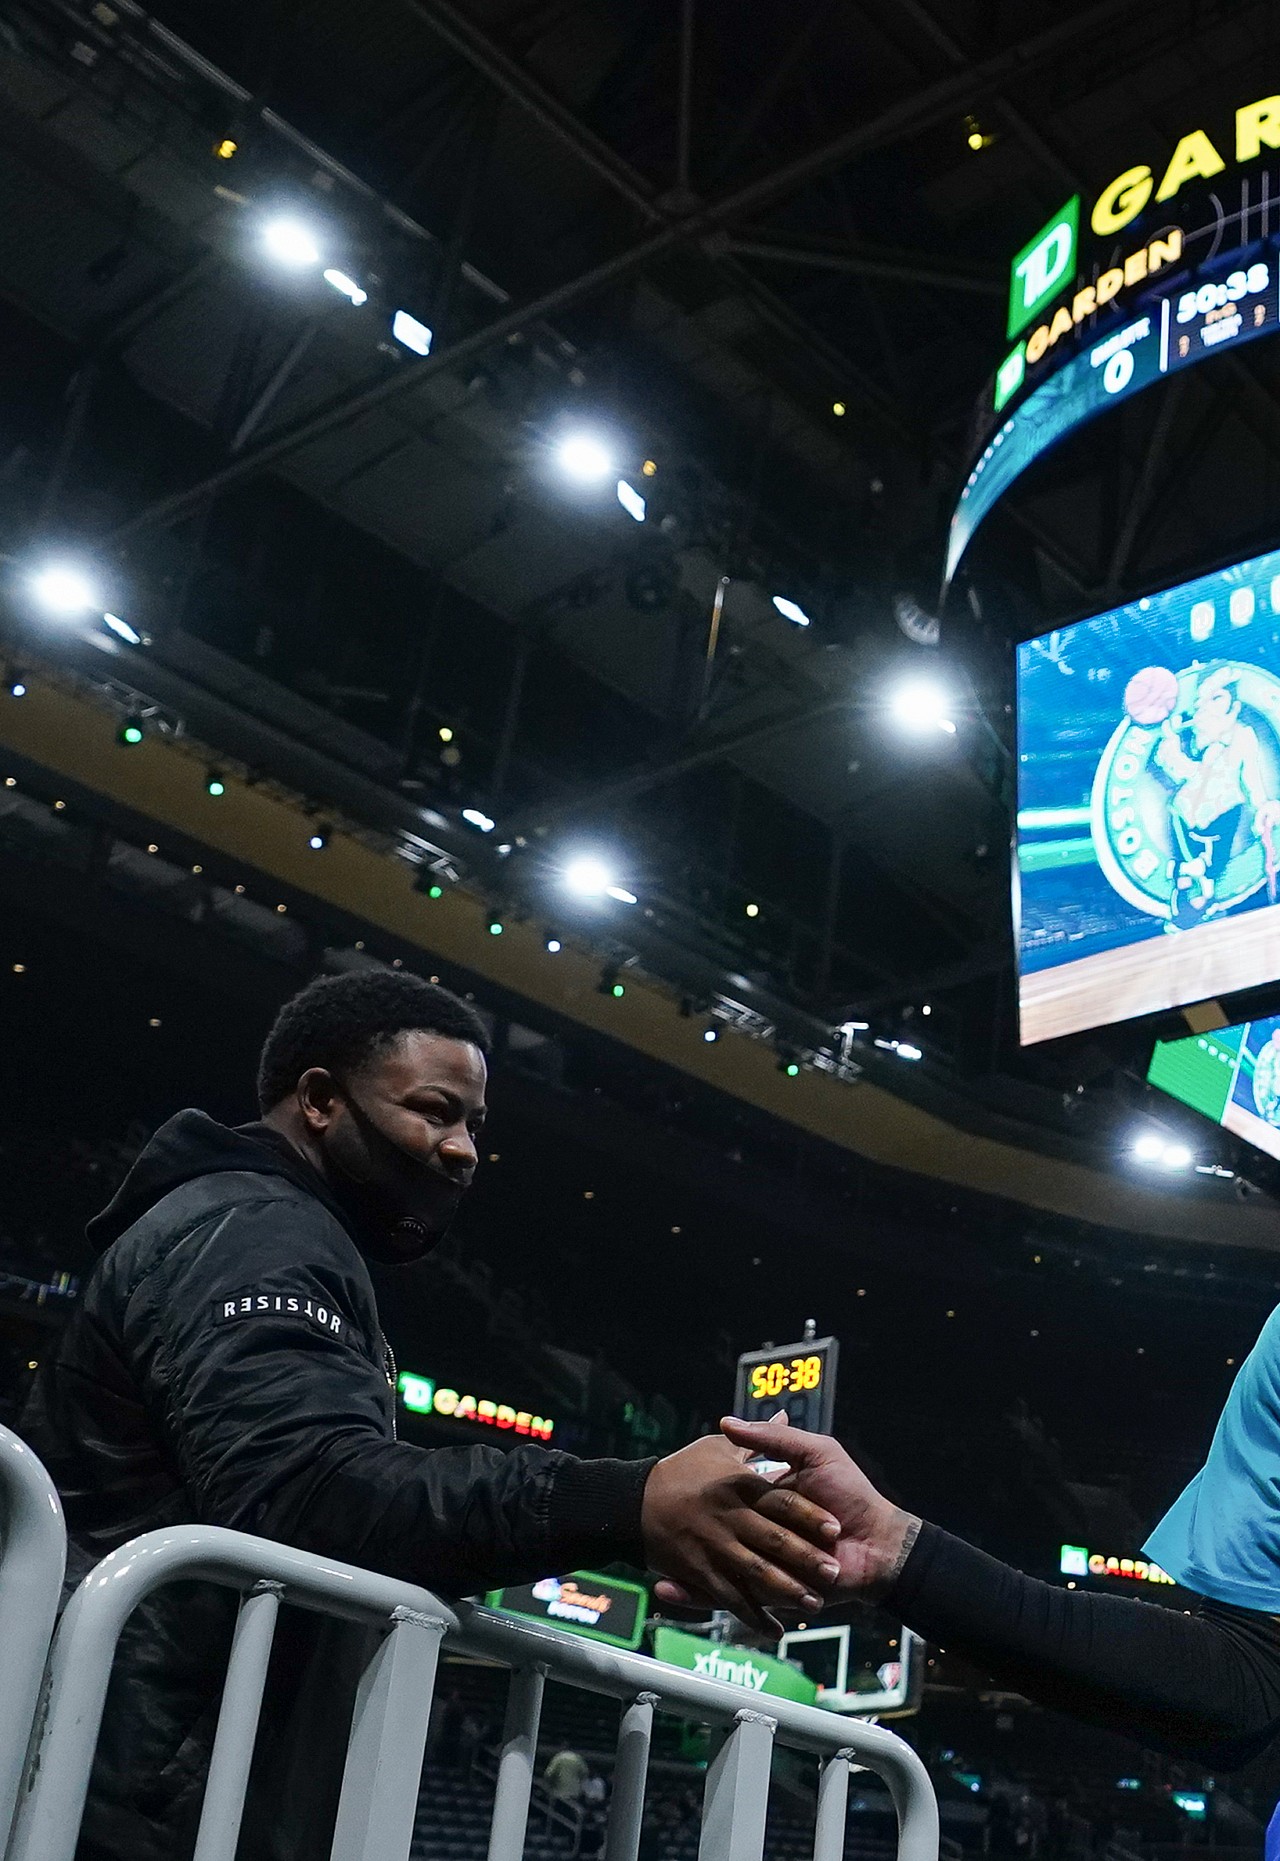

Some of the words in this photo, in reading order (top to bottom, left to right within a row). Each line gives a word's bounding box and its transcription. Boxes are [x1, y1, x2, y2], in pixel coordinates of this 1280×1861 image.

[1015, 222, 1072, 307] TD
[1026, 229, 1182, 364] GARDEN
[1176, 263, 1269, 323] 50:38
[1103, 349, 1134, 394] 0
[752, 1356, 821, 1399] 50:38
[433, 1388, 554, 1441] GARDEN
[692, 1650, 769, 1691] xfinity
